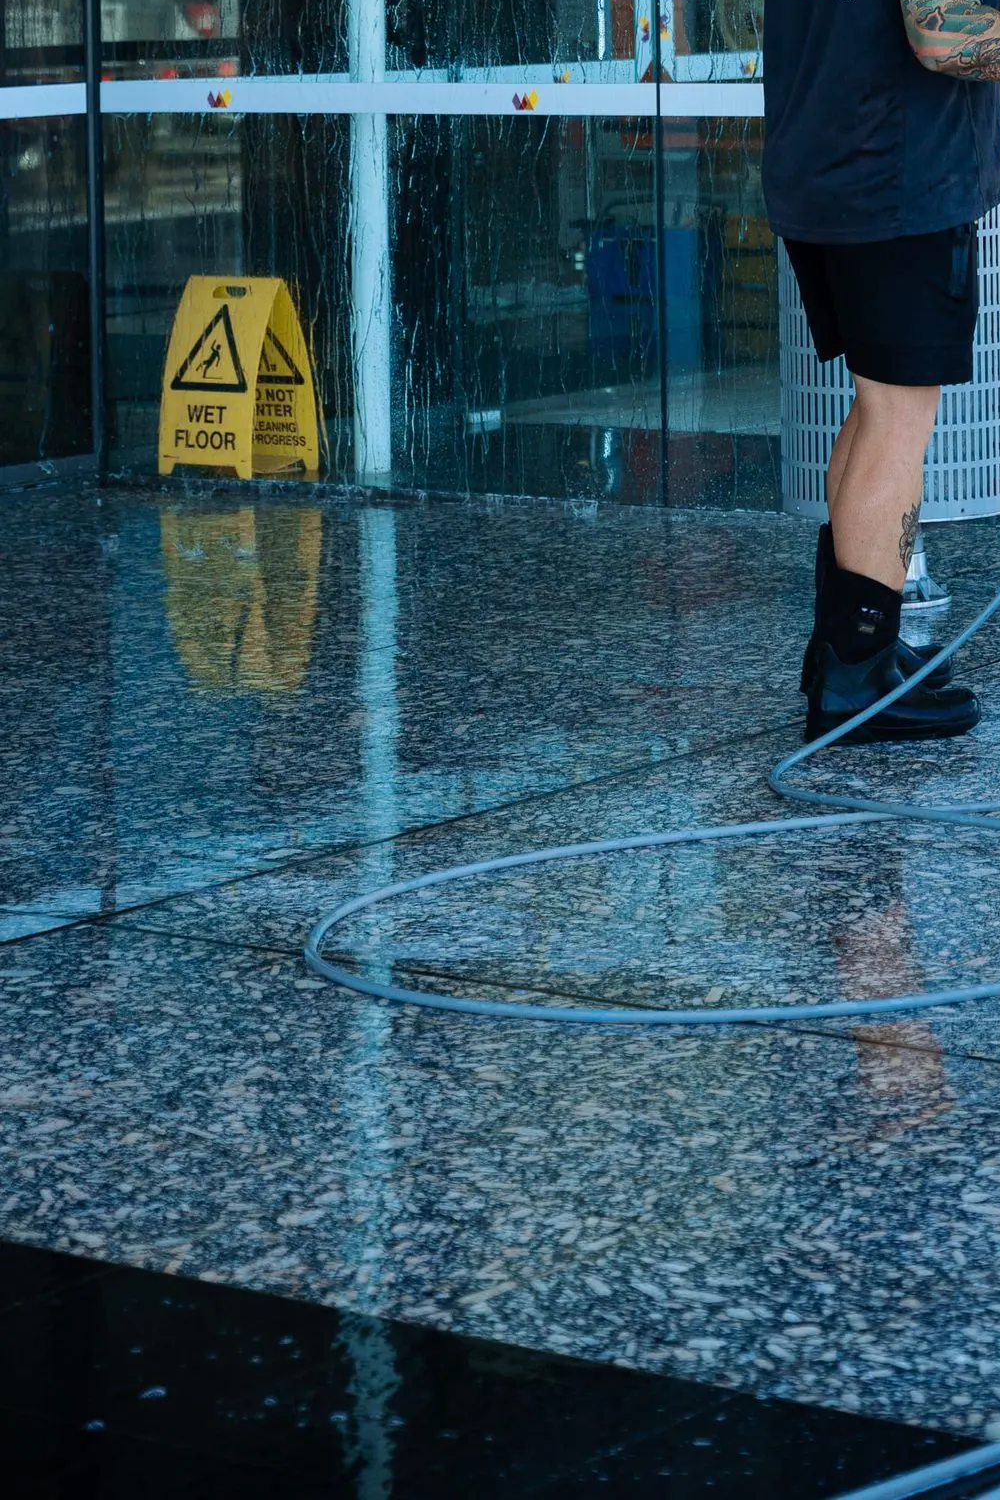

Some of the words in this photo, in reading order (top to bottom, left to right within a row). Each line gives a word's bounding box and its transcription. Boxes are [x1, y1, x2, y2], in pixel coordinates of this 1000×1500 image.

[265, 388, 294, 402] NOT
[187, 404, 227, 424] WET
[256, 403, 293, 417] NTER
[254, 421, 297, 433] LEANING
[174, 429, 236, 451] FLOOR
